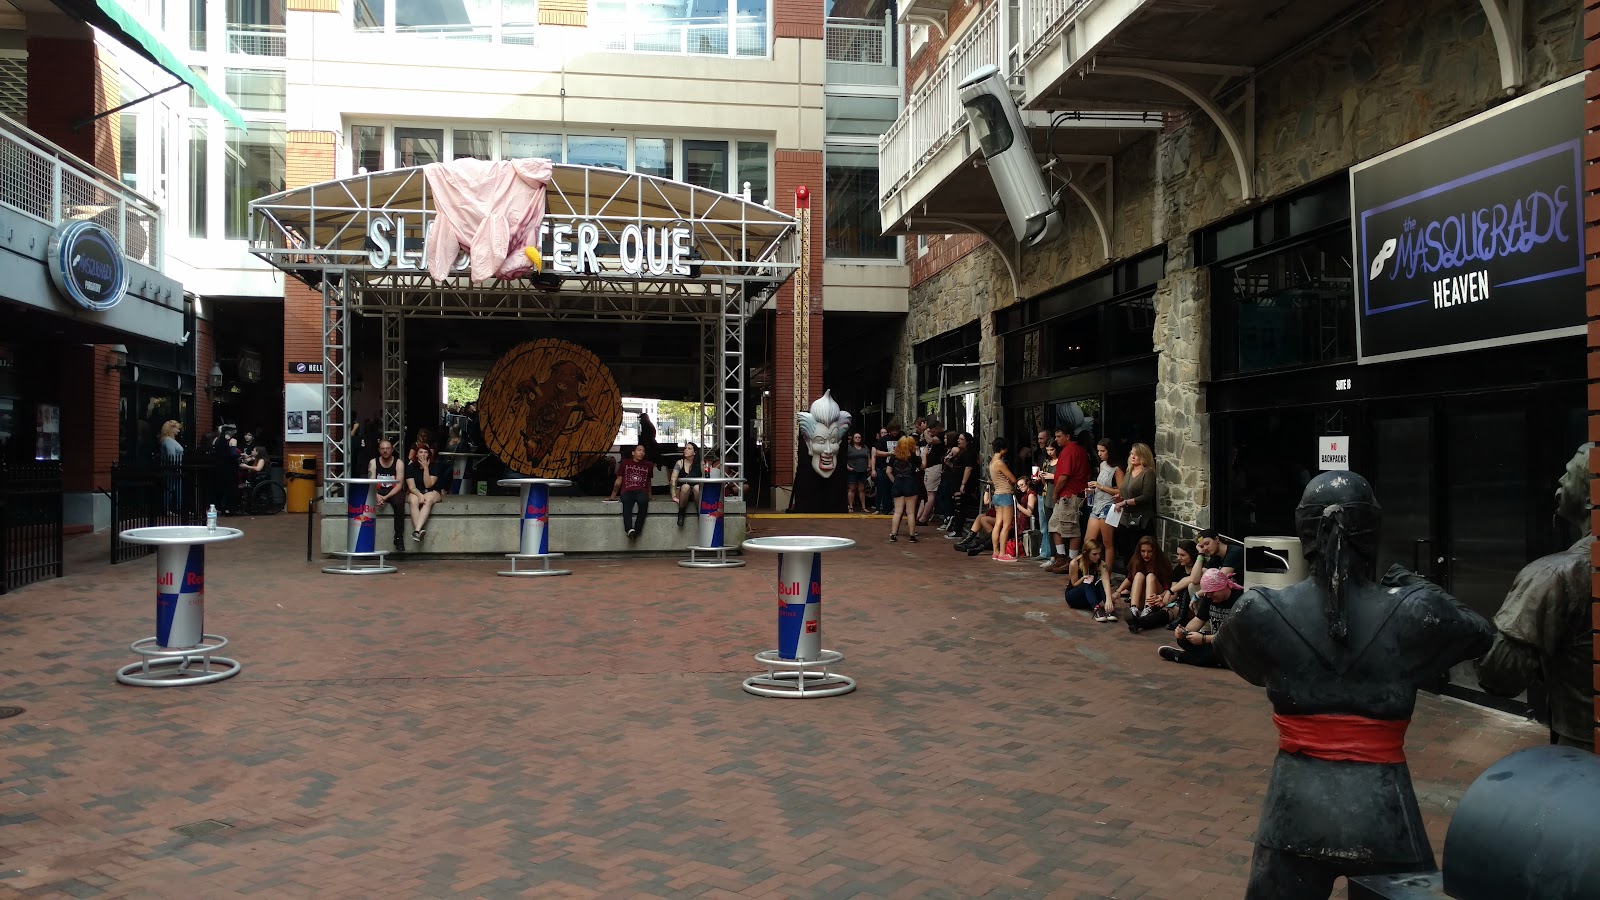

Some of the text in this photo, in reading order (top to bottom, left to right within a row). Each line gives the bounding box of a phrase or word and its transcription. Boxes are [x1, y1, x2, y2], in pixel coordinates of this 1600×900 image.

[1403, 215, 1417, 234] the
[1389, 184, 1570, 281] MASQUERADE
[619, 221, 692, 279] QUE
[1433, 269, 1490, 310] HEAVEN
[308, 364, 323, 372] HELL
[1330, 442, 1338, 451] NO
[1321, 454, 1347, 464] BACKPACKS
[701, 501, 718, 510] Red
